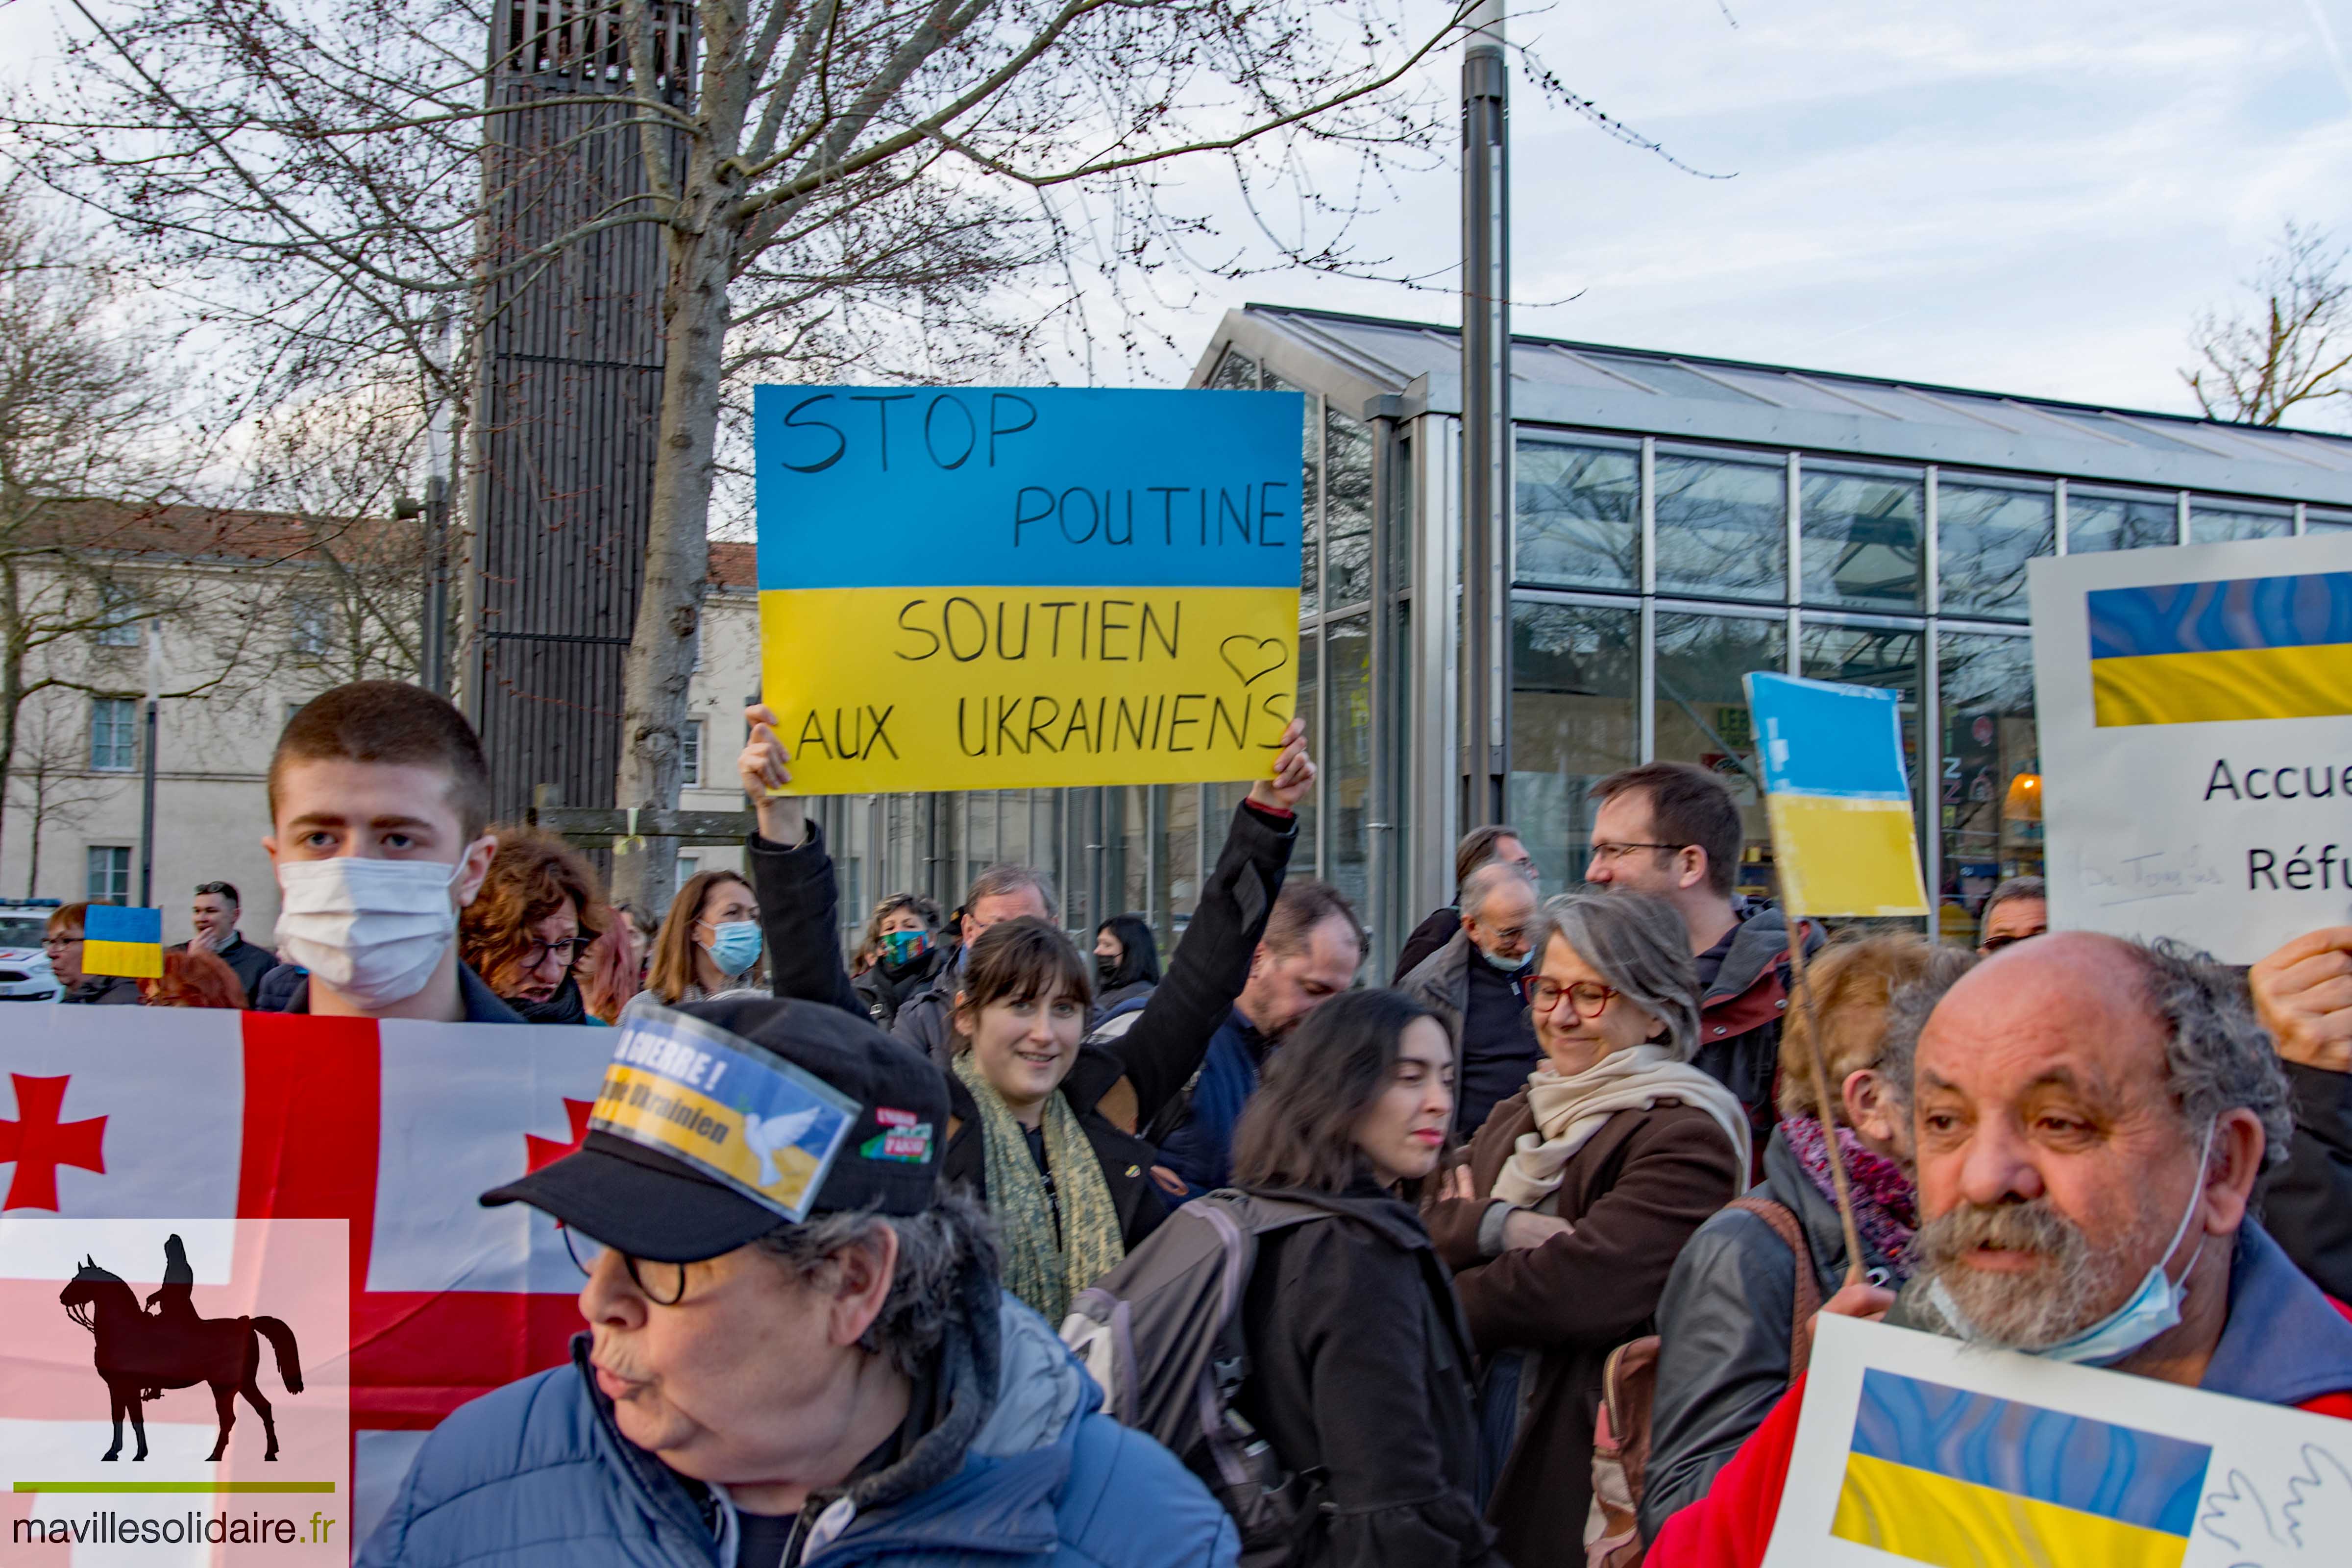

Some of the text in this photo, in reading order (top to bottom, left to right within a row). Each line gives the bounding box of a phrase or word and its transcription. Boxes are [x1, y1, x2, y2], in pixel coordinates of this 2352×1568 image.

[782, 393, 1037, 474] STOP
[1014, 482, 1288, 547] POUTINE
[895, 597, 1180, 662] SOUTIEN
[795, 693, 1291, 761] AUX UKRAINIENS
